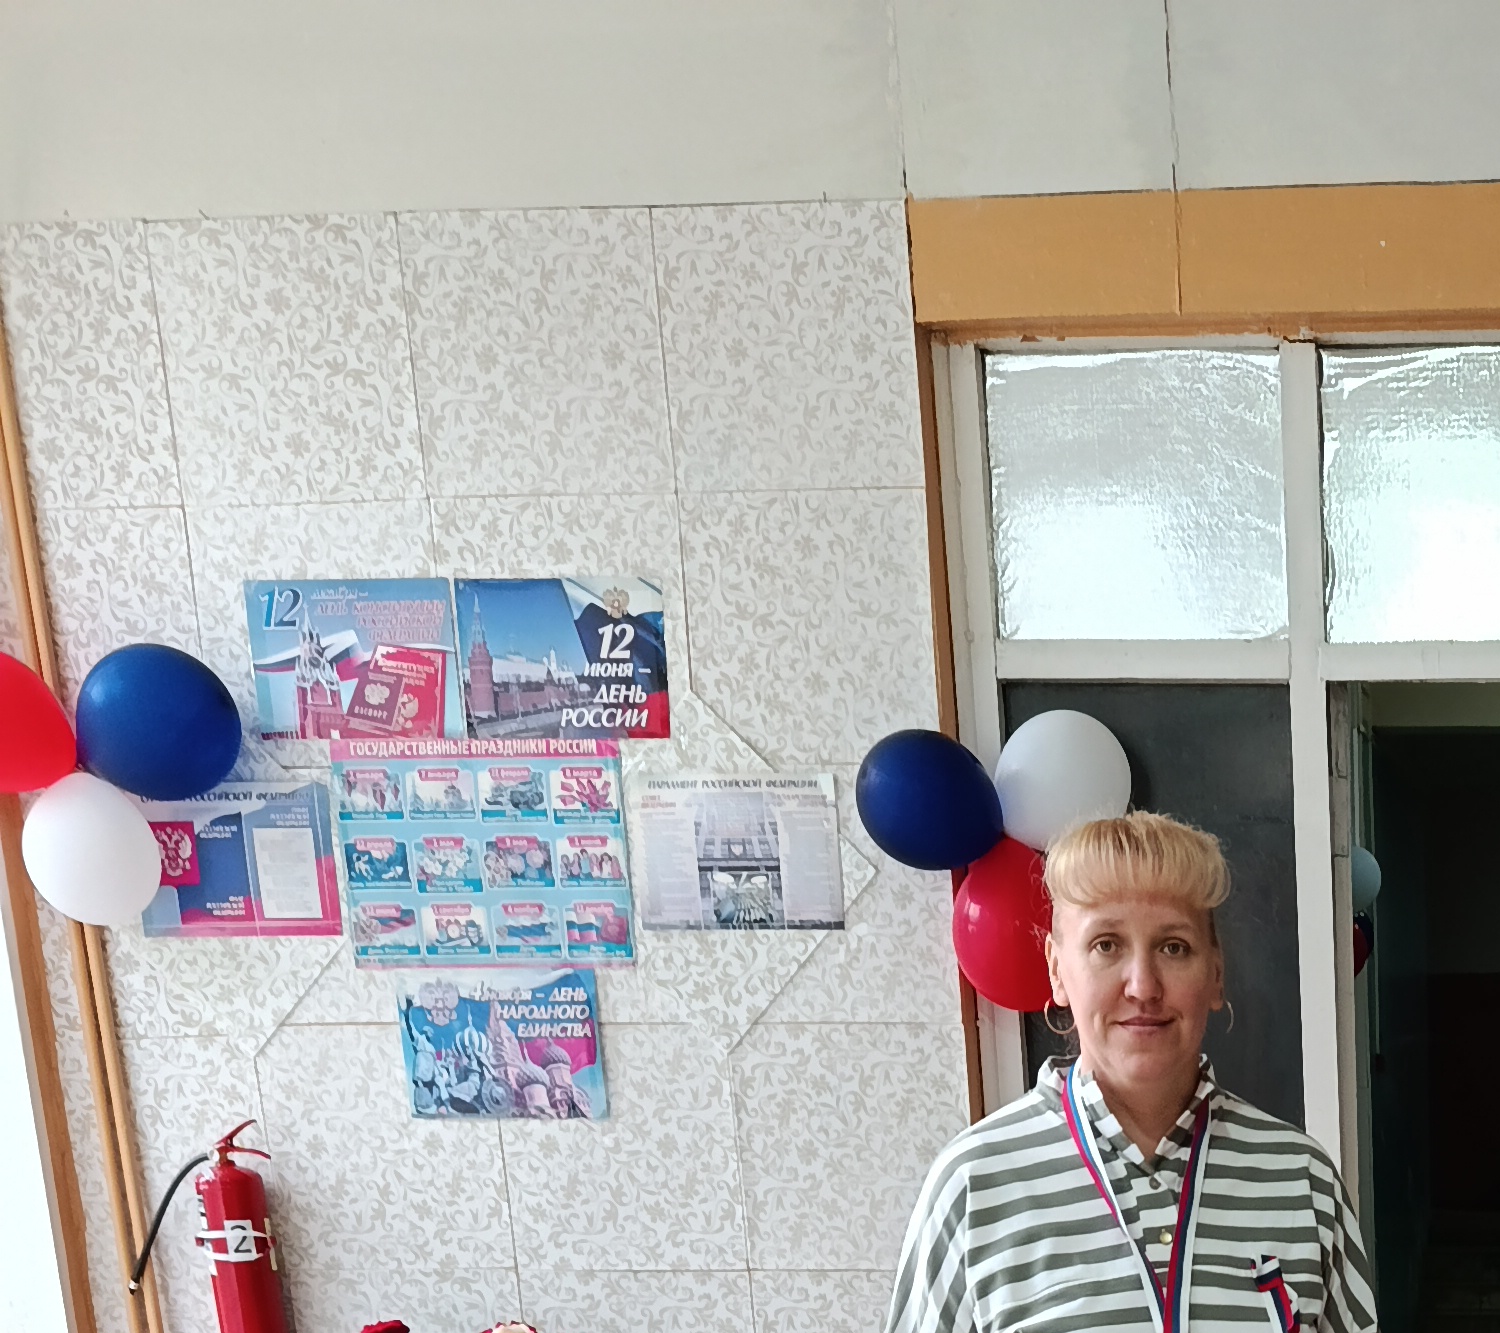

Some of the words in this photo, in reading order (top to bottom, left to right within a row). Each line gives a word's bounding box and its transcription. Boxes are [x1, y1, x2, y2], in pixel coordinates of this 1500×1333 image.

[259, 586, 303, 631] 12
[598, 623, 635, 659] 12
[593, 684, 647, 704] ДЕНЬ
[561, 708, 649, 728] РОССИИ
[349, 740, 469, 758] ГОСУДАРСТВЕННЫЕ
[470, 739, 546, 756] ПРАЗДНИКИ
[550, 738, 597, 754] РОССИИ
[549, 987, 588, 1001] ДЕНЬ
[496, 1004, 590, 1020] НАРОДНОГО
[518, 1022, 592, 1037] ЕДИНСТВА
[231, 1225, 252, 1253] 2
